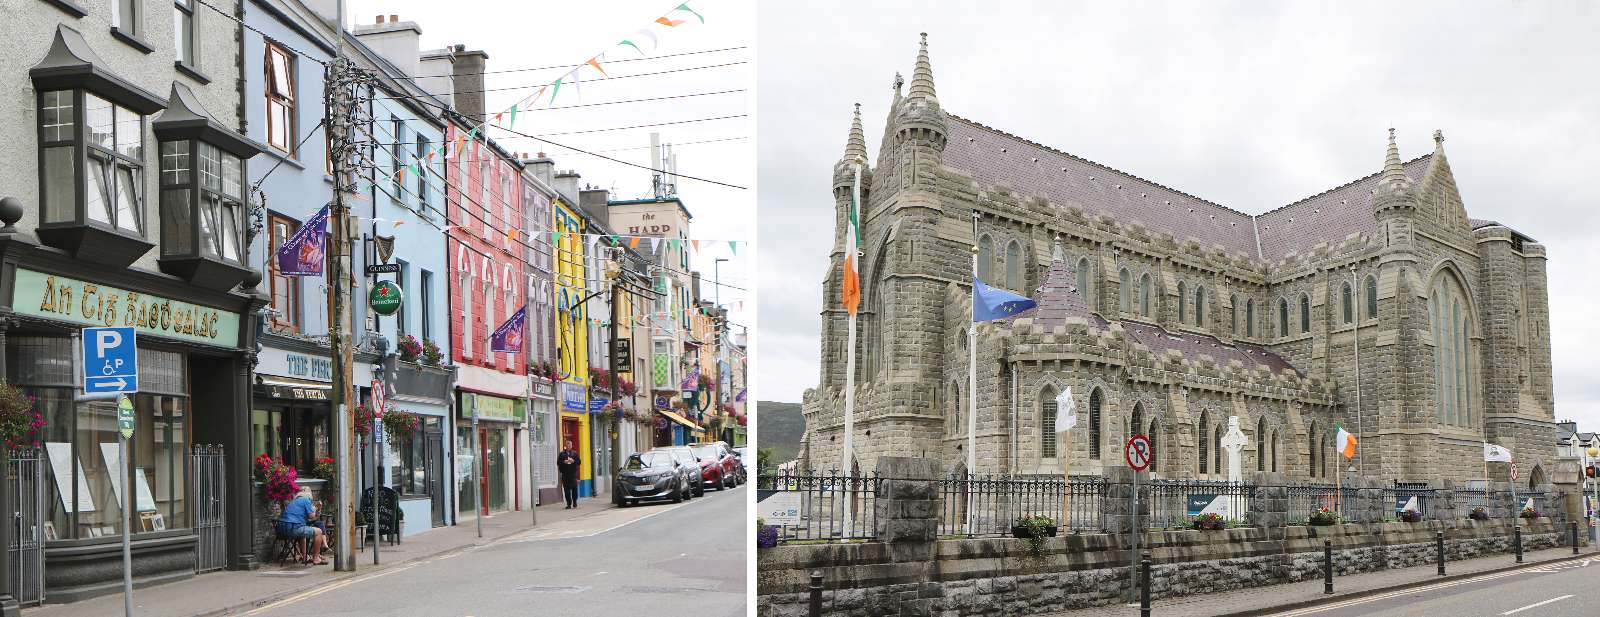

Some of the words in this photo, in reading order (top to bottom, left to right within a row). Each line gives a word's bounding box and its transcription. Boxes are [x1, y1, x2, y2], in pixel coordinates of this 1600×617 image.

[642, 213, 656, 221] the
[629, 224, 671, 234] HARP
[40, 275, 73, 315] An
[97, 330, 122, 358] P
[115, 359, 124, 368] P
[287, 354, 308, 376] THE
